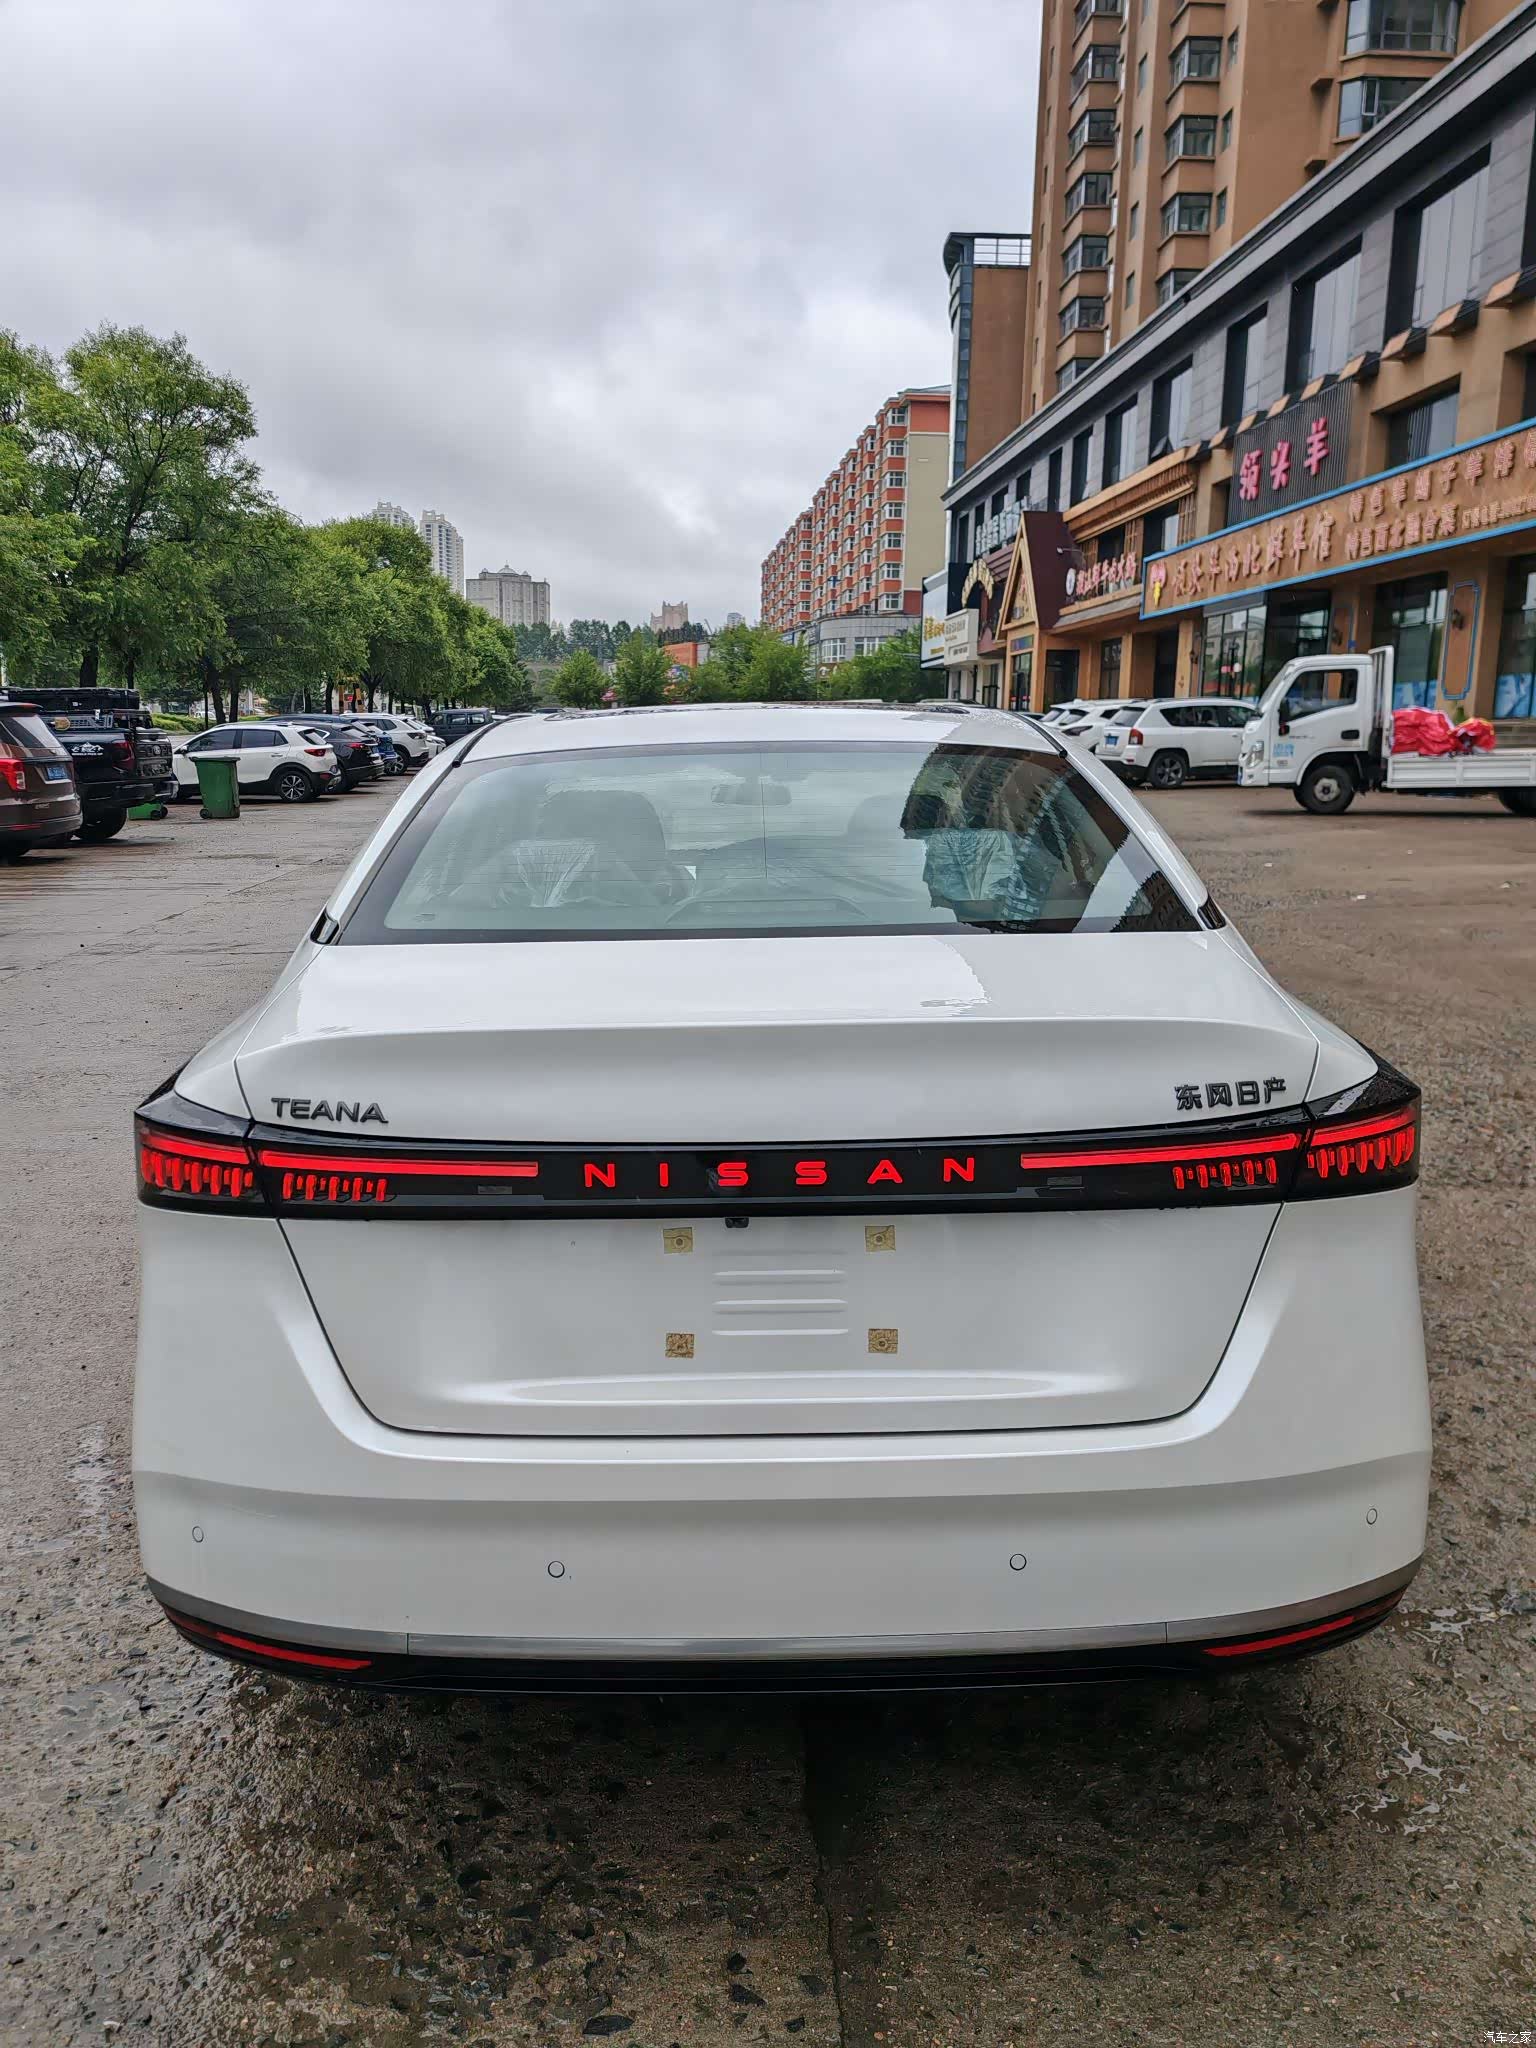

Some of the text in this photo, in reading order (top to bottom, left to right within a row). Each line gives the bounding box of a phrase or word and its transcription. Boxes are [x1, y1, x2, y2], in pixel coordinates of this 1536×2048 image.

[1240, 417, 1329, 501] 领头羊
[1174, 1076, 1287, 1111] 东风日产
[271, 1097, 389, 1124] TEANA
[583, 1157, 976, 1189] NISSAN
